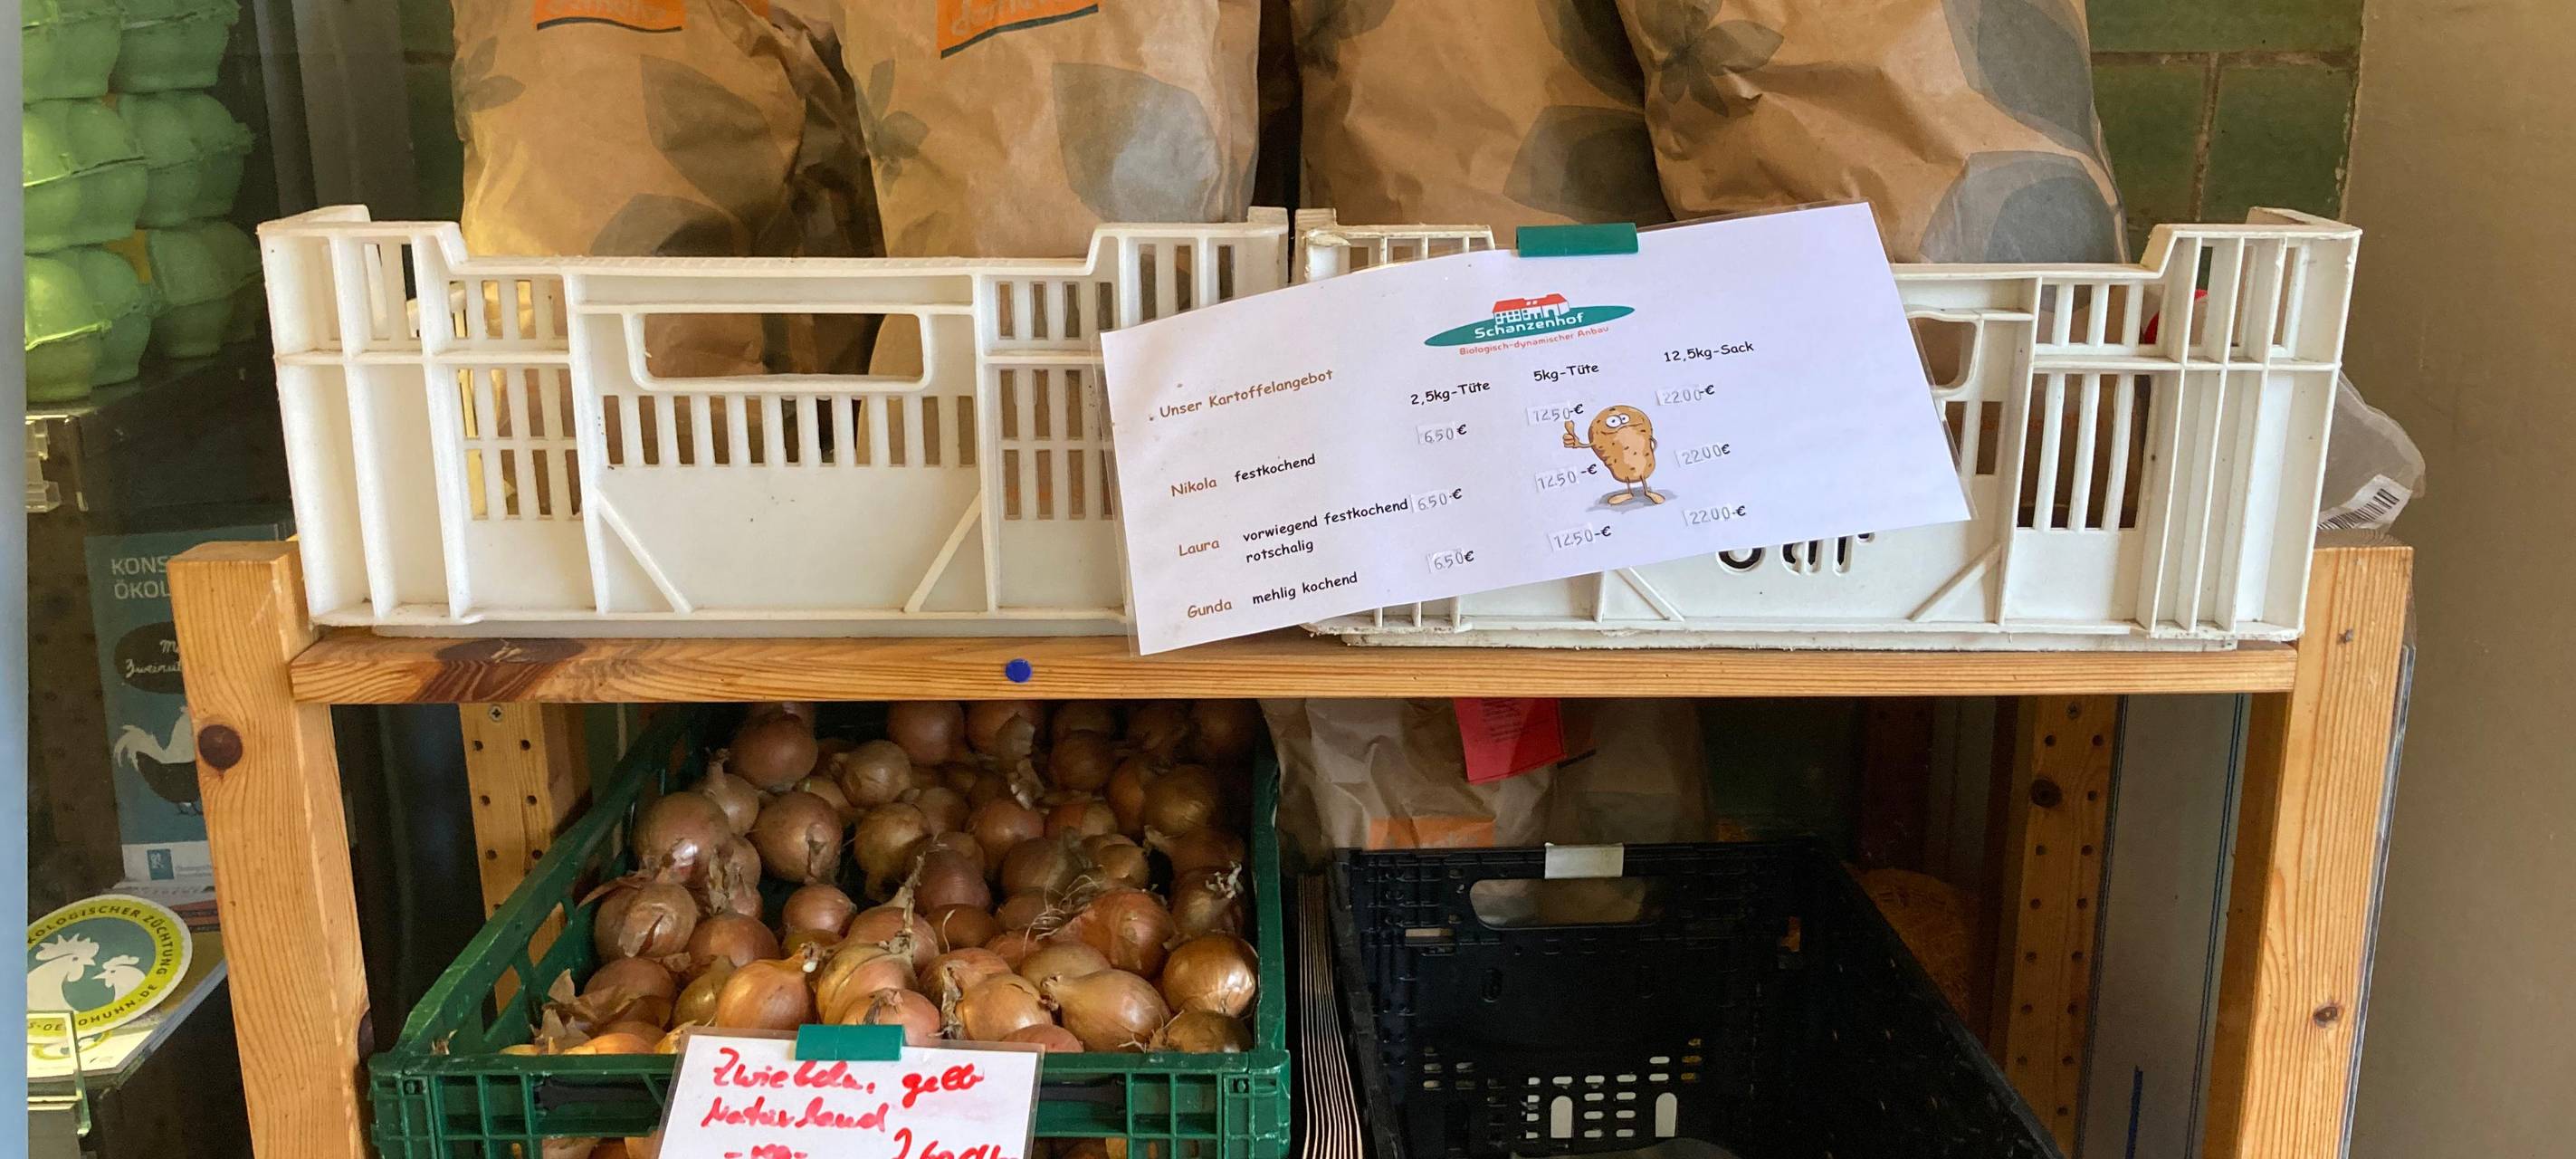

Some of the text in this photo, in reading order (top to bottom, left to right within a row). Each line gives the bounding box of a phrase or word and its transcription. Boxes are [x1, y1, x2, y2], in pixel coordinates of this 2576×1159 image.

[1459, 326, 1609, 356] Biologisch-dynamischer Anbau
[1474, 312, 1584, 340] Schanzenhof
[1664, 340, 1754, 362] 12,5kg-Sack
[1533, 363, 1599, 382] 5kg-Tüte
[1159, 369, 1333, 418] Unser Kartoffelangebot
[1410, 381, 1491, 406] 2,5kg-Tüte
[1171, 453, 1315, 497] Nikola festkochend
[1178, 498, 1408, 557] Laura vorwiegend festkochend
[1245, 540, 1313, 563] rotschalig
[1187, 571, 1358, 618] Gunda mehlig kochend
[143, 914, 174, 976] ZÜCHTUNG
